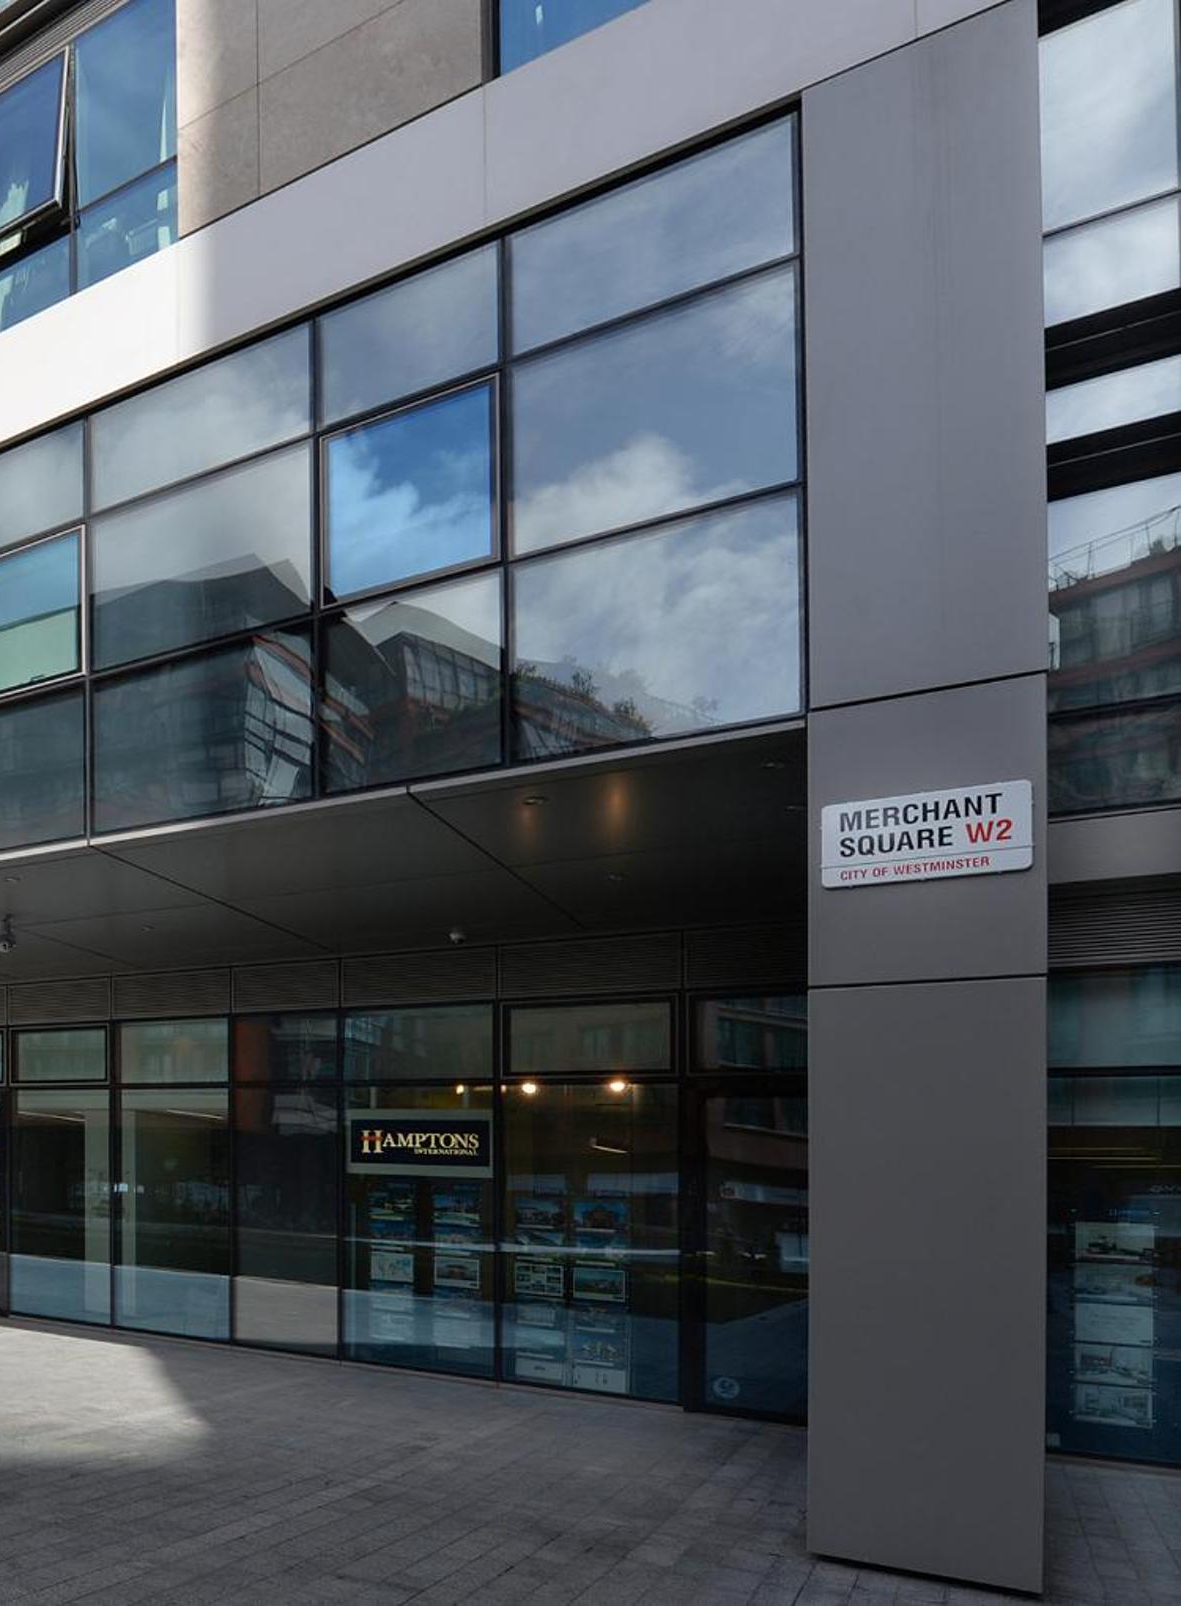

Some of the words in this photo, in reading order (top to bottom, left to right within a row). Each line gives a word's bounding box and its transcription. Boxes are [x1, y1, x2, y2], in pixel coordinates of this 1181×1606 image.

[840, 793, 1002, 832] MERCHANT
[840, 826, 953, 857] SQUARE
[966, 819, 1012, 843] W2
[840, 869, 868, 881] CITY
[872, 867, 888, 877] OF
[894, 856, 989, 875] WESTMINSTER
[361, 1130, 479, 1153] HAMPTONS
[415, 1148, 478, 1156] INTERNATIONAL
